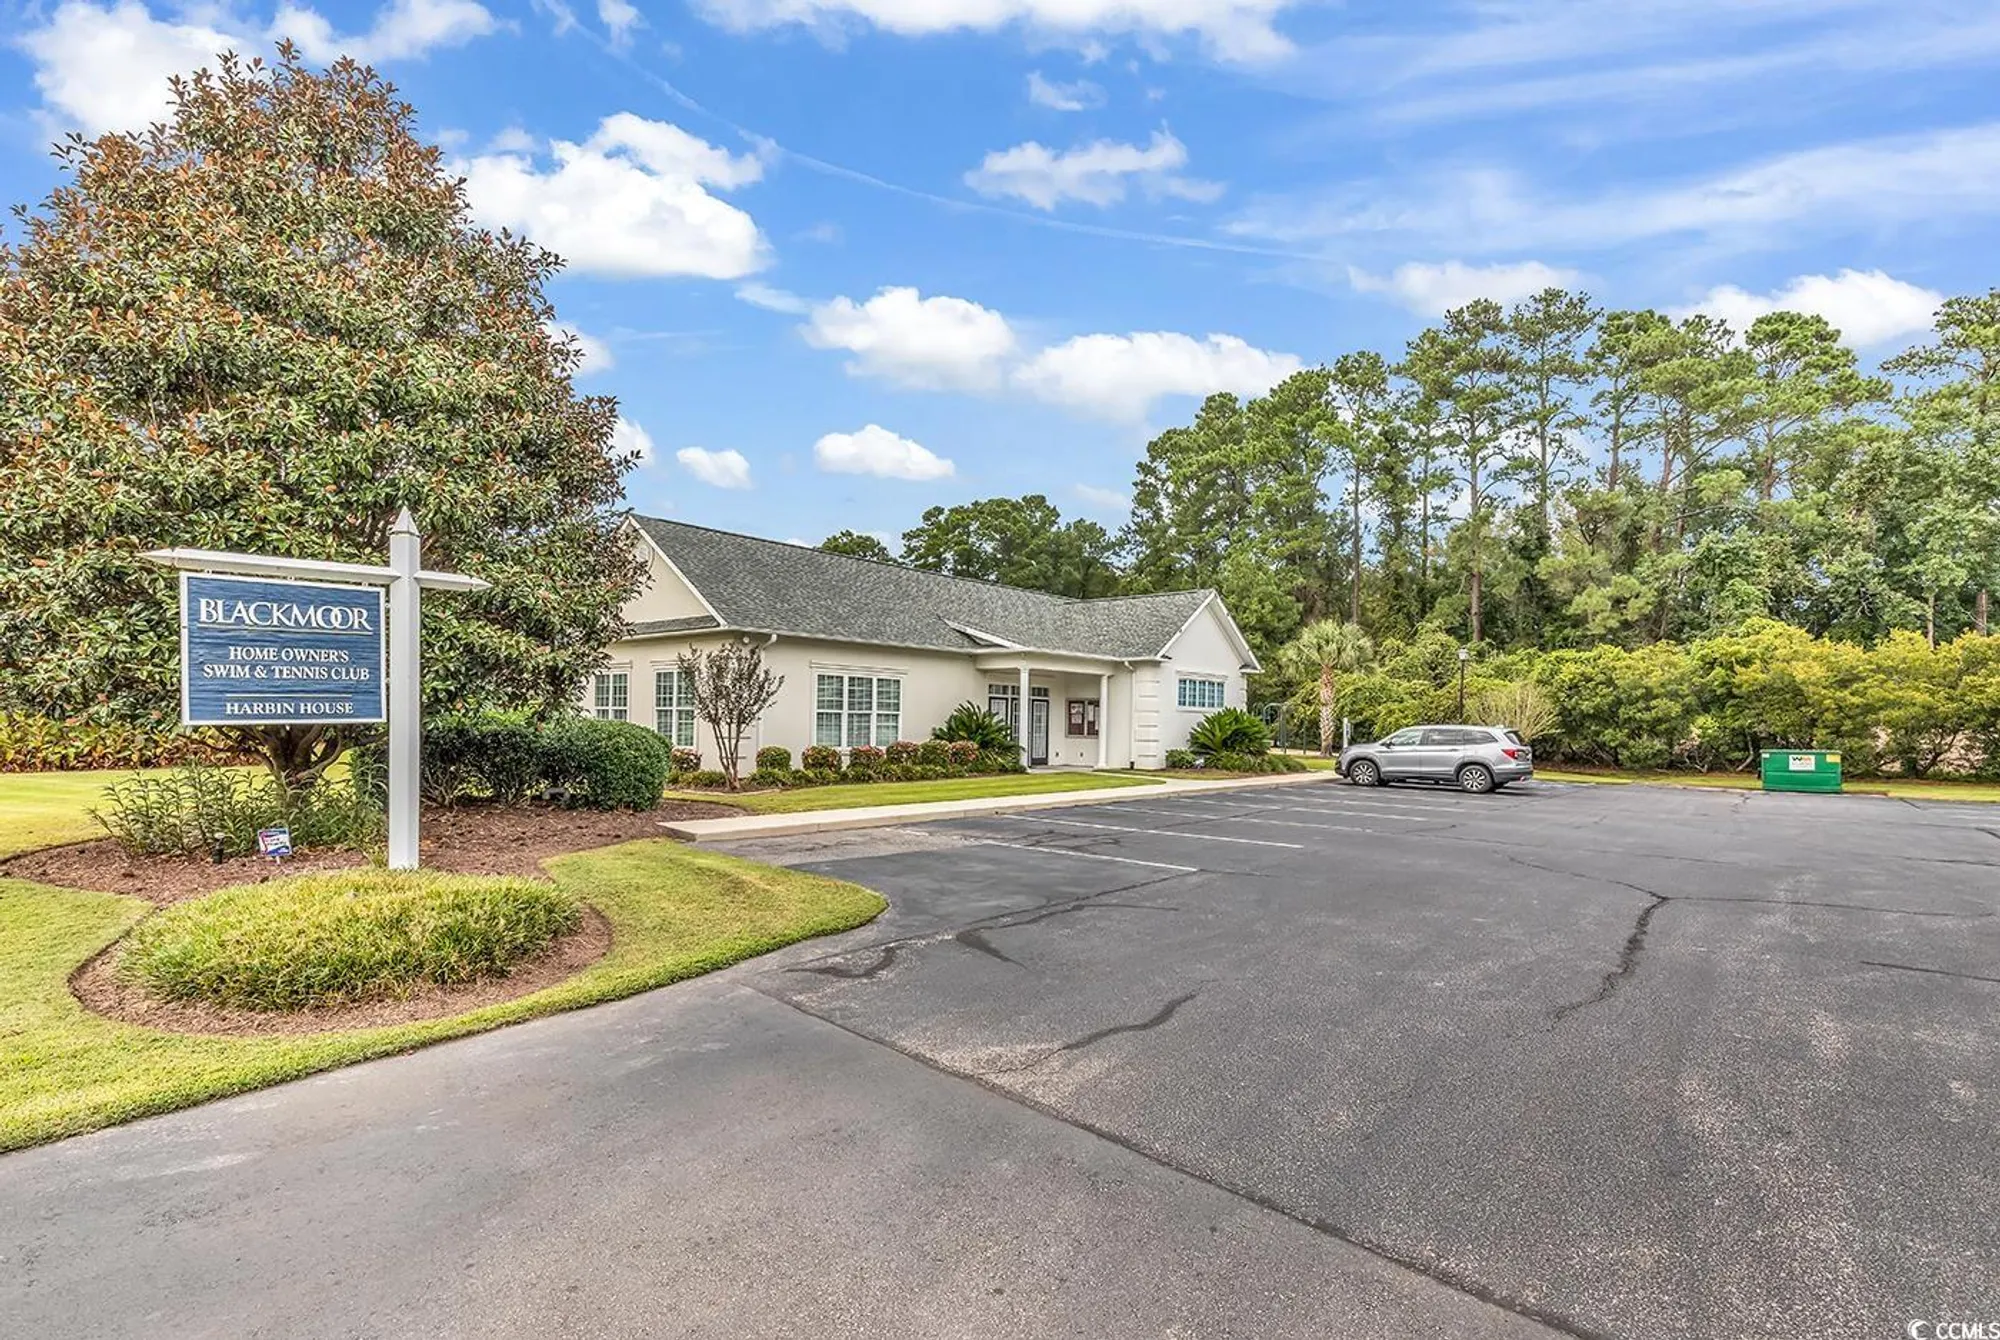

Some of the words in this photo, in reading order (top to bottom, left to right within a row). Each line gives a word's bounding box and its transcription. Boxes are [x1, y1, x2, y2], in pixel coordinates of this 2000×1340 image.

[198, 598, 373, 630] BLACKMOOR
[229, 646, 278, 662] HOME
[281, 648, 349, 663] OWNER'S
[203, 664, 250, 679] SWIM
[254, 666, 268, 679] &
[271, 666, 328, 680] TENNIS
[331, 667, 370, 680] CLUB
[226, 701, 295, 715] HARBIN
[300, 702, 354, 714] HOUSE
